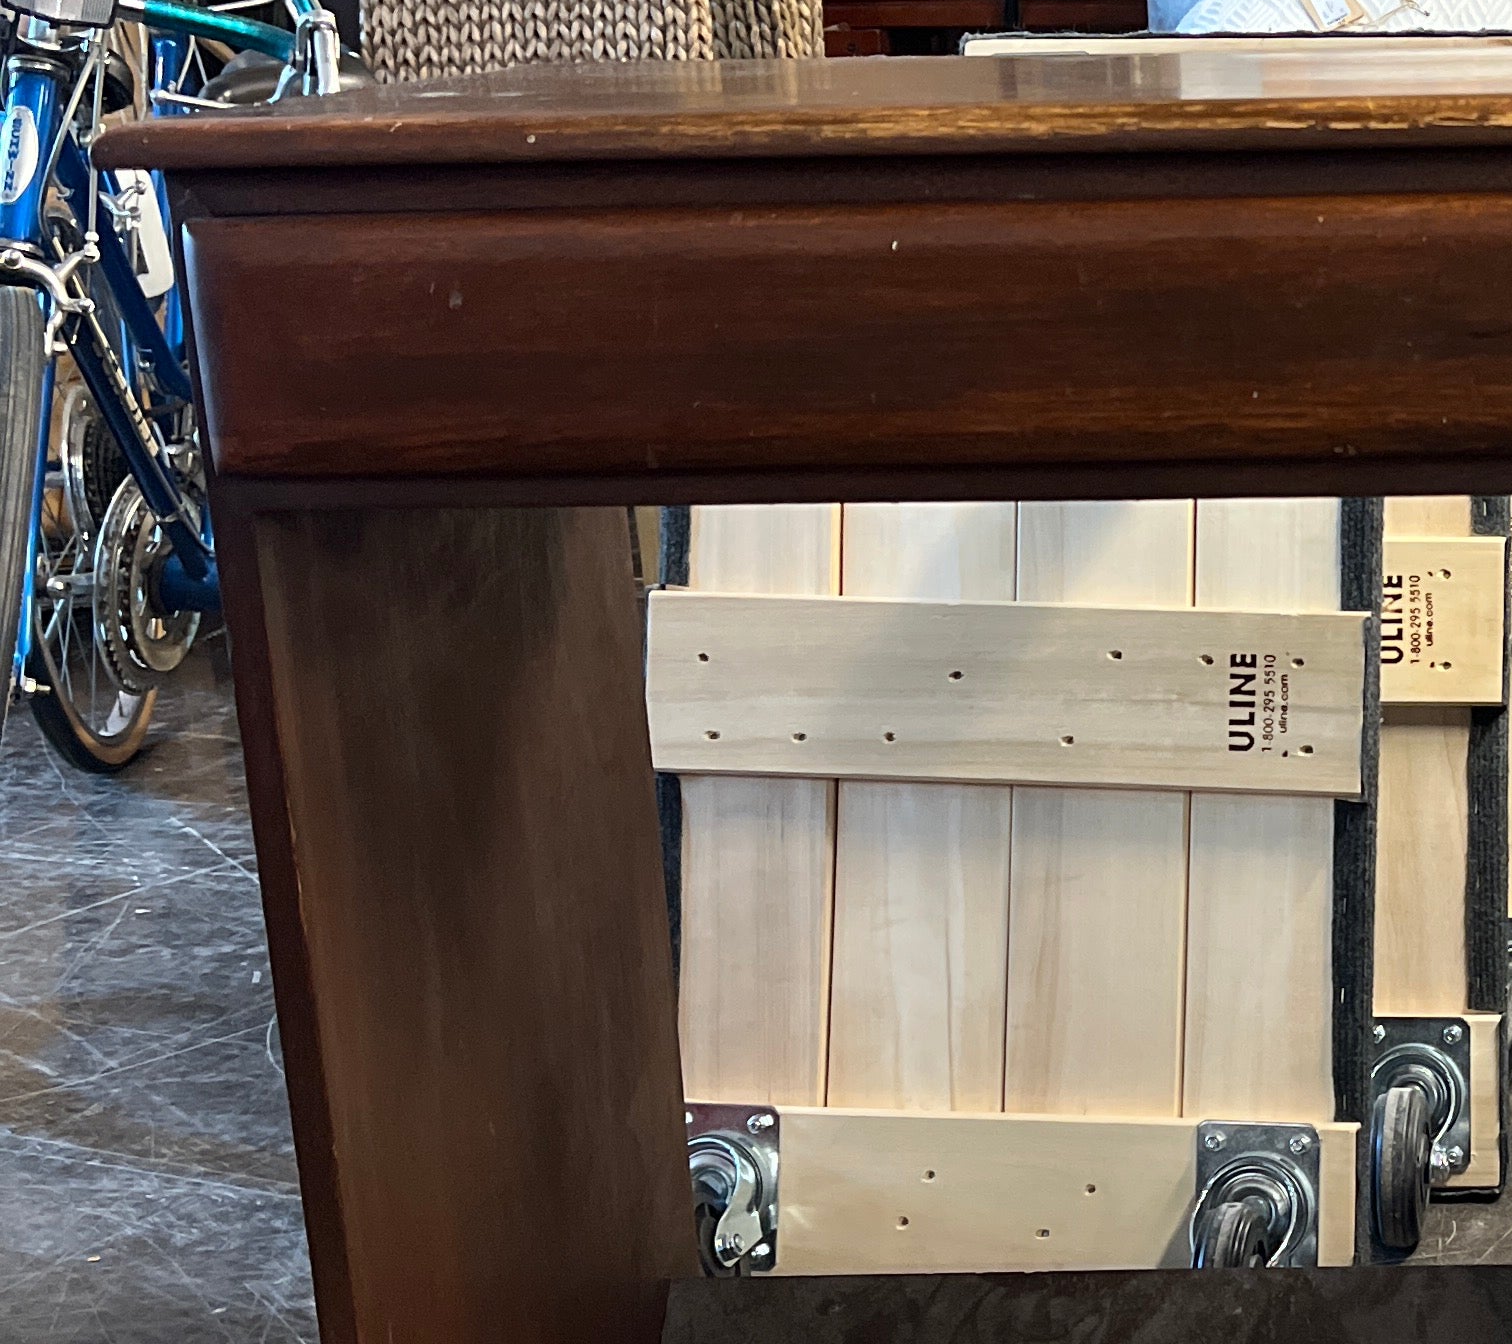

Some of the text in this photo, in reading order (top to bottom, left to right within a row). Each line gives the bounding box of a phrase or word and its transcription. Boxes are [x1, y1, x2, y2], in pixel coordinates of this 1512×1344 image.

[1380, 575, 1404, 664] ULINE
[1424, 592, 1434, 647] uline.com
[1228, 653, 1257, 751] ULINE
[1279, 674, 1289, 734] uline.com
